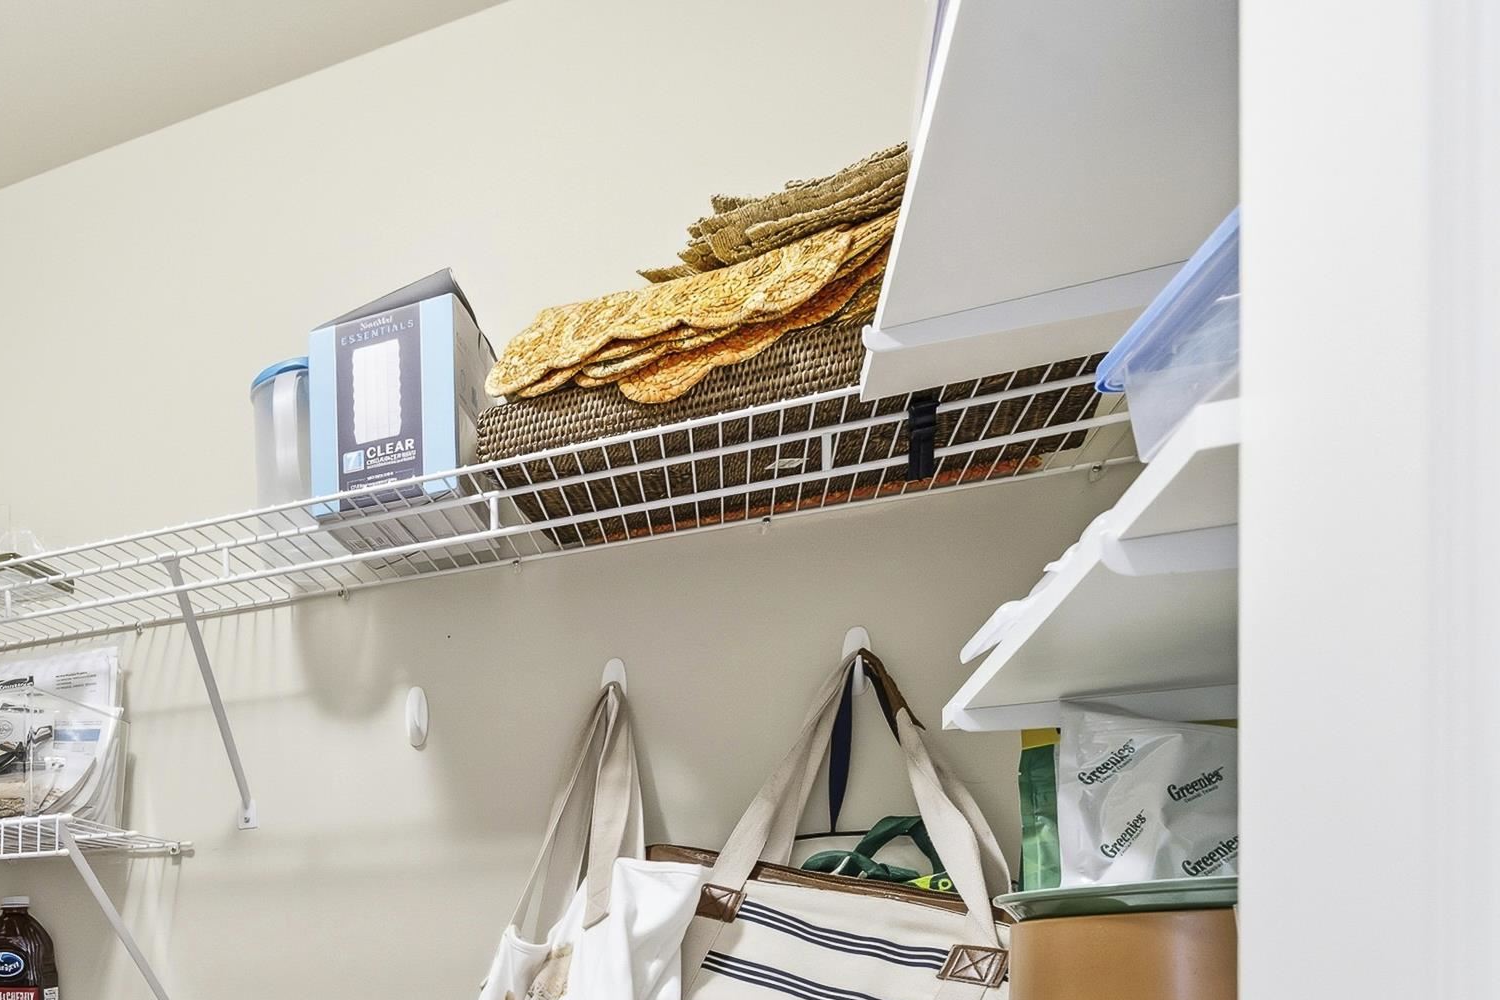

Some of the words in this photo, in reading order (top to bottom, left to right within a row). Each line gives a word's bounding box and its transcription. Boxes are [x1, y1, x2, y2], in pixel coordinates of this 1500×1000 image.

[341, 319, 414, 346] ESSENTIALS
[366, 438, 415, 460] CLEAR
[1077, 741, 1136, 786] Greenies
[1167, 769, 1224, 802] Greenies
[1099, 812, 1147, 860] Greenies
